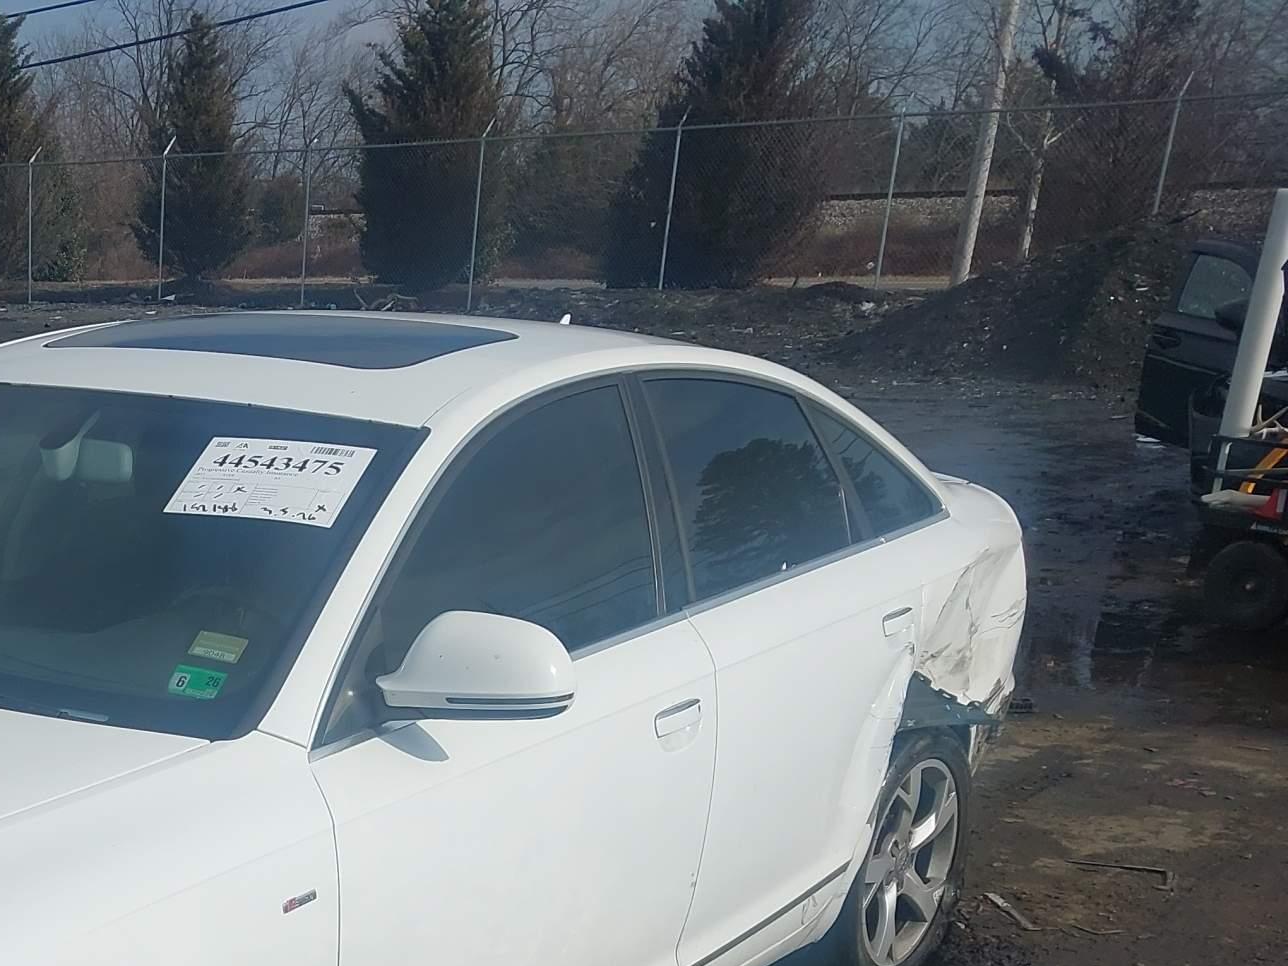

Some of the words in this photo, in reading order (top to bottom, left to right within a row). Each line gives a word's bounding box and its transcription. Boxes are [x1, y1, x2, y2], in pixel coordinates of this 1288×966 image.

[213, 454, 344, 475] 44543475
[176, 676, 187, 687] 6
[206, 677, 221, 687] 26
